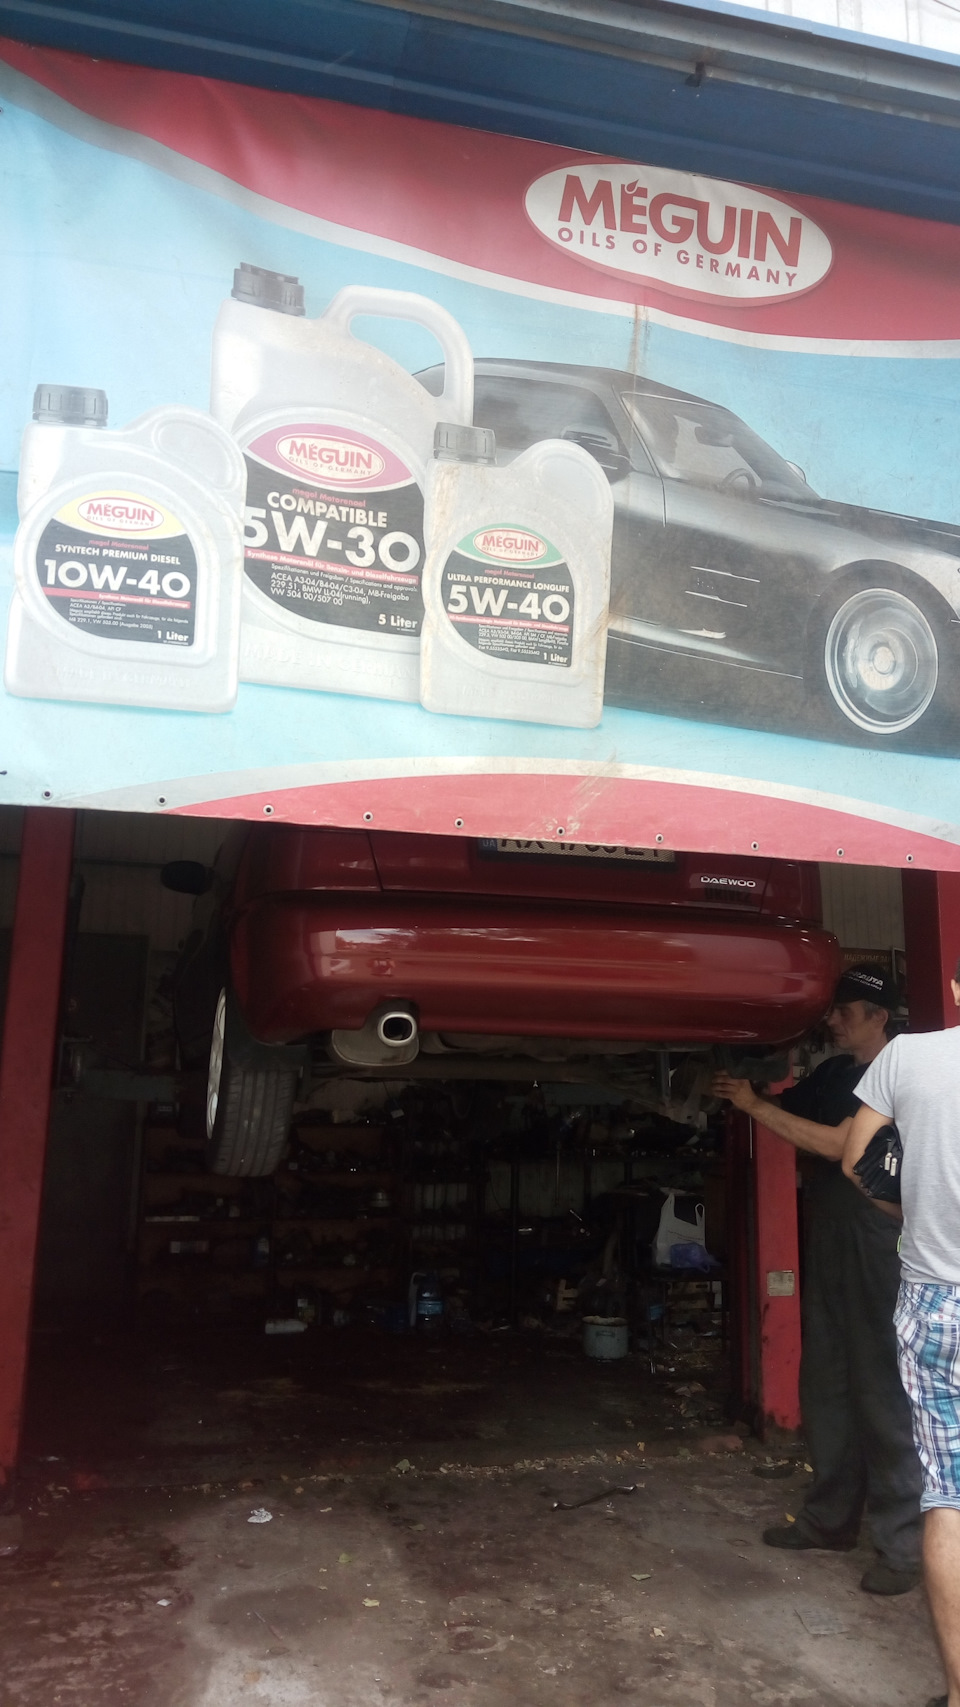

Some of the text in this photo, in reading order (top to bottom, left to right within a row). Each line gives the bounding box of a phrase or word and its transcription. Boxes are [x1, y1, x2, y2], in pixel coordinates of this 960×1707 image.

[557, 226, 798, 287] OILS OF GERMANY
[288, 455, 309, 466] OILS
[327, 465, 373, 476] GERMANY
[292, 487, 318, 499] megol
[266, 491, 388, 528] COMPATIBLE
[244, 505, 421, 573] 5W-30
[55, 544, 181, 565] SYNTECH PREMIUM DIESEL
[247, 550, 279, 561] Synthese
[351, 568, 364, 576] und
[44, 558, 191, 599] 10W-40
[270, 572, 293, 582] ACEA
[447, 572, 570, 593] ULTRA PERFORMANCE LONGLIFE
[270, 587, 343, 606] VW 504 00/507 00
[302, 584, 323, 594] BMW
[447, 584, 570, 623] 5W-40
[378, 613, 418, 629] 5 Liter
[157, 630, 189, 642] 1 Liter
[543, 652, 568, 663] 1 Liter
[700, 875, 757, 888] DAEWOO
